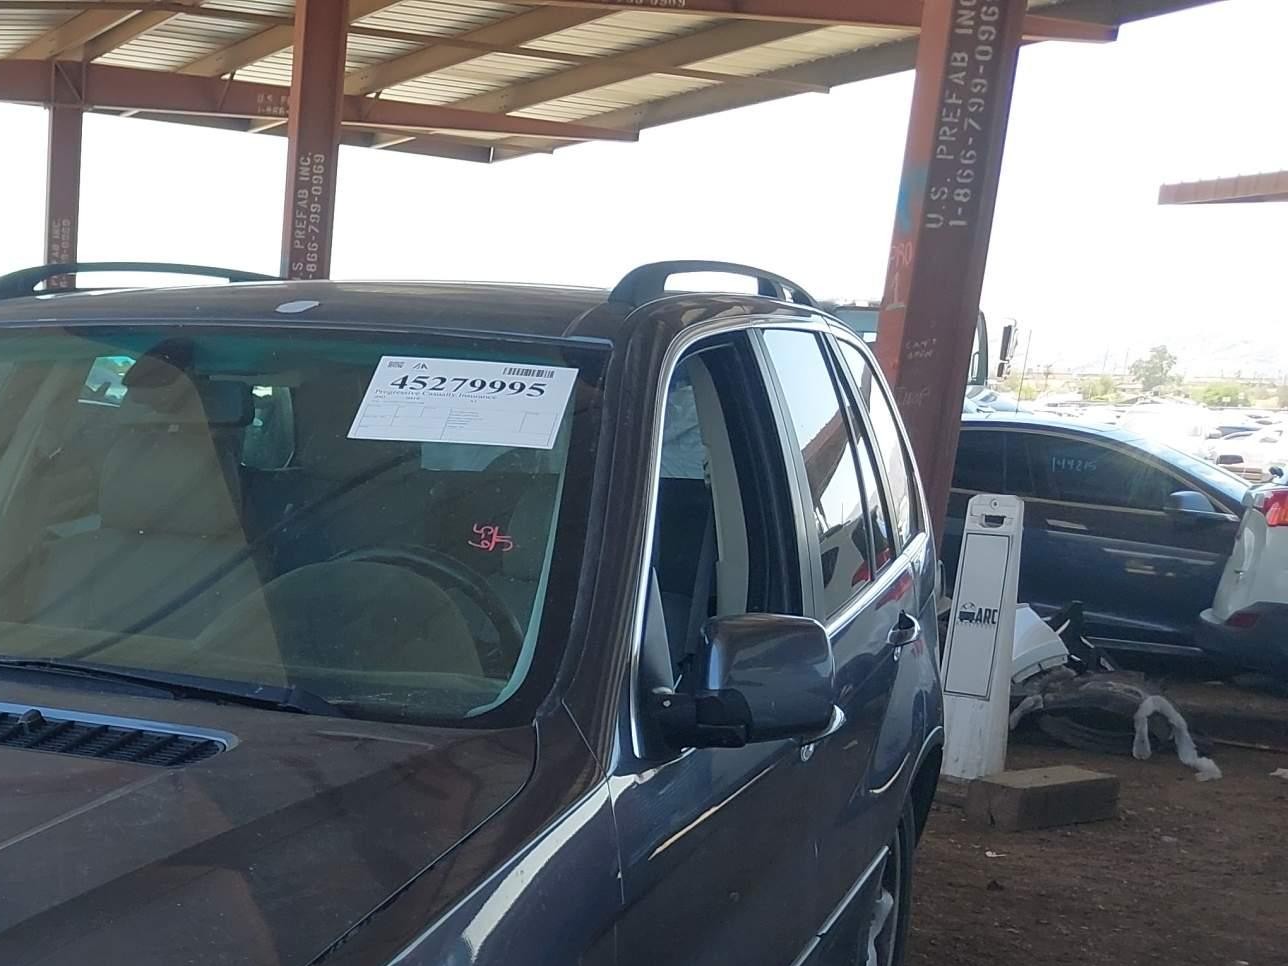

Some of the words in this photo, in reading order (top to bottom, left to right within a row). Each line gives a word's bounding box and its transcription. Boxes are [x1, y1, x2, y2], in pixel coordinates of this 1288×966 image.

[936, 51, 969, 160] PREFAB
[948, 0, 1000, 227] 1-866-799-096
[298, 151, 313, 181] INC.
[294, 189, 310, 249] PREFAB
[305, 153, 326, 279] -866-799-0969
[389, 374, 548, 398] 45279995
[975, 607, 999, 625] ARC
